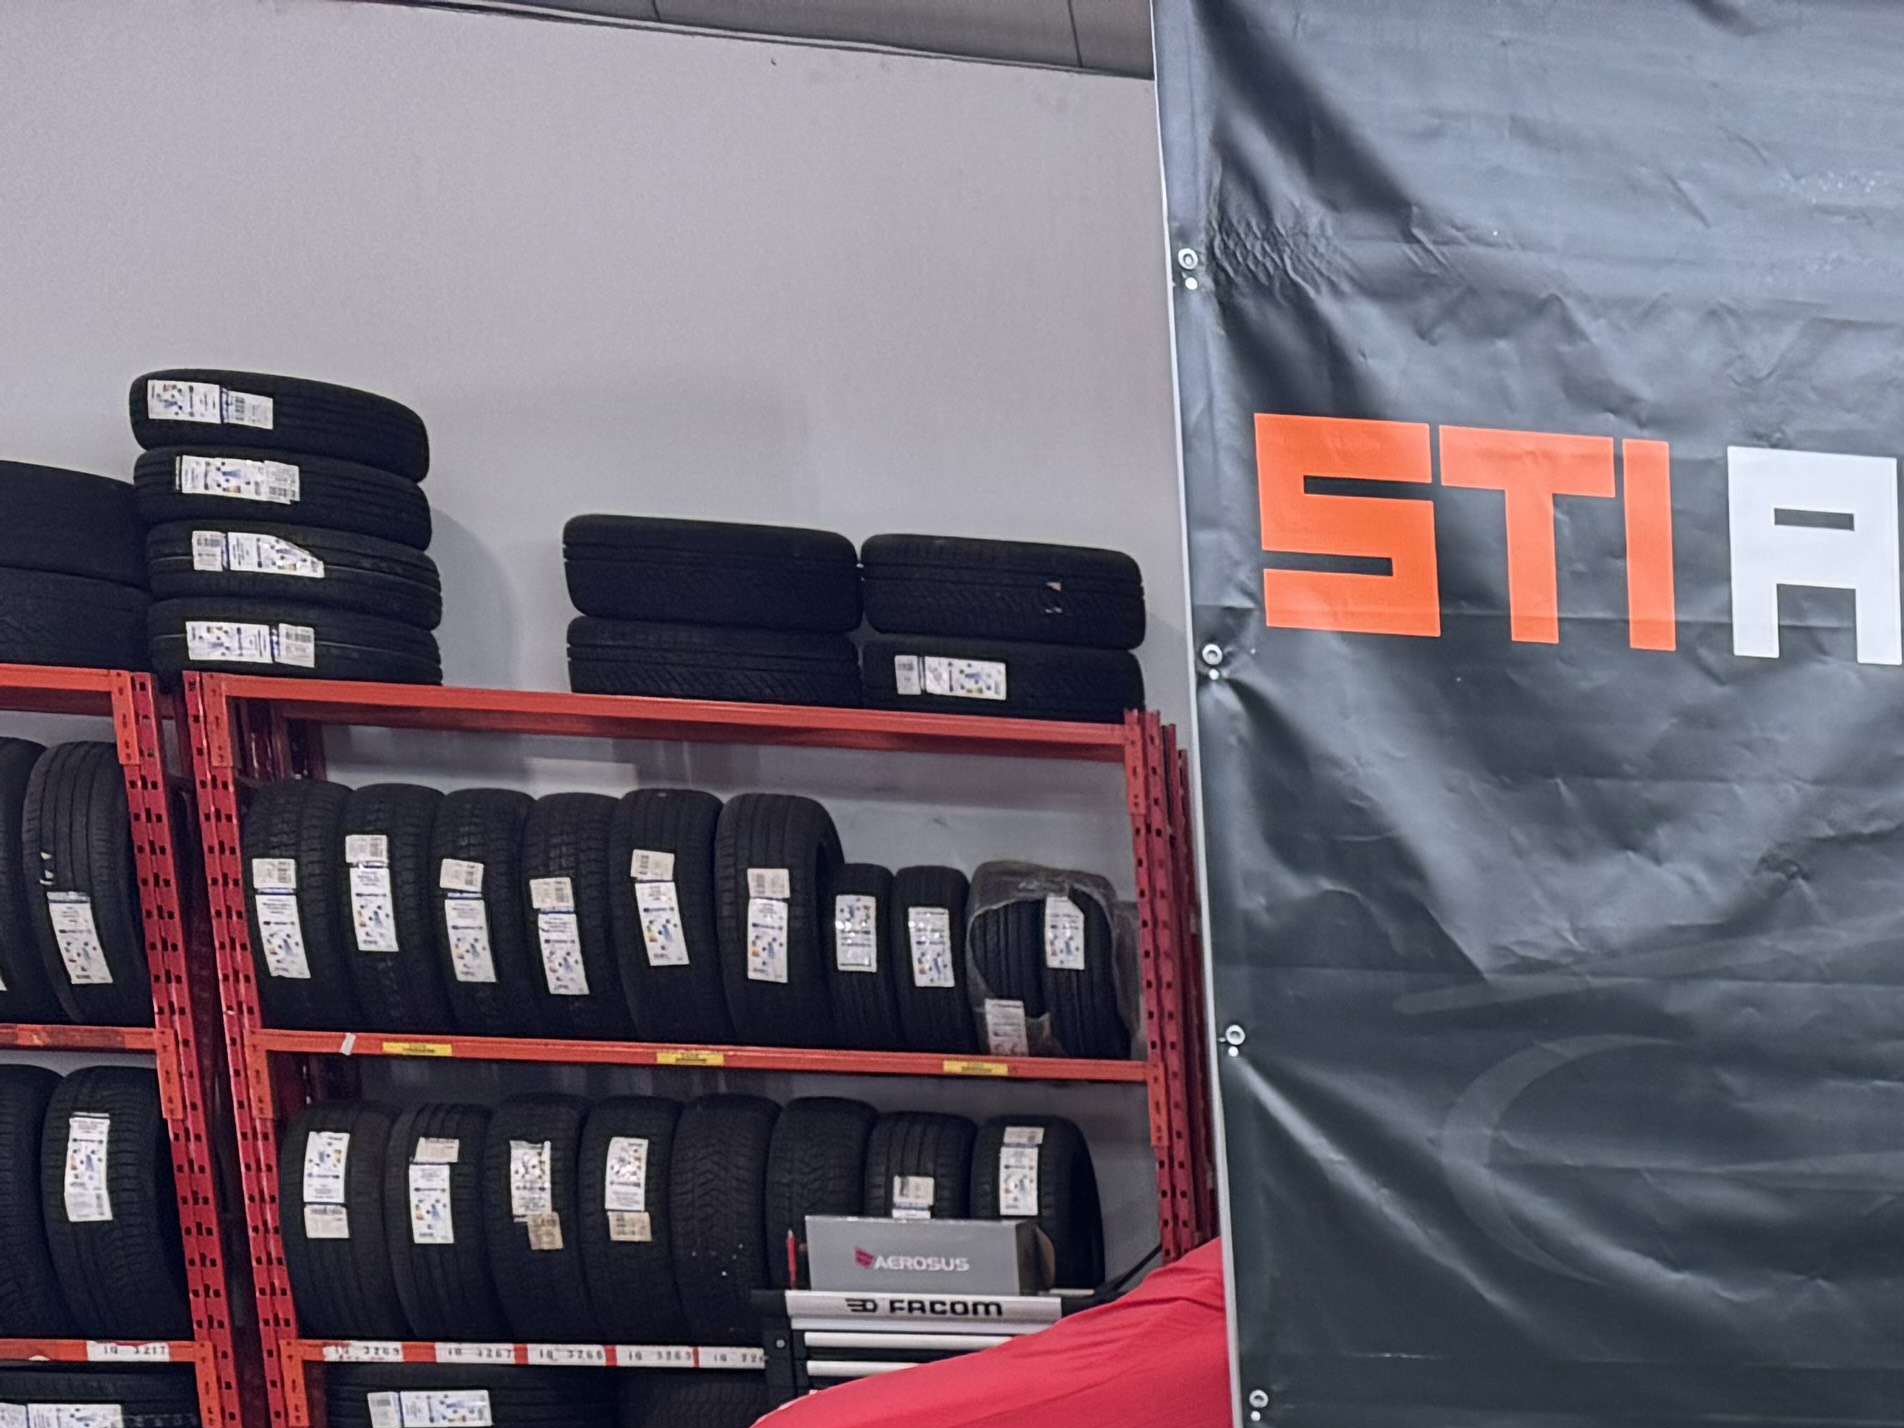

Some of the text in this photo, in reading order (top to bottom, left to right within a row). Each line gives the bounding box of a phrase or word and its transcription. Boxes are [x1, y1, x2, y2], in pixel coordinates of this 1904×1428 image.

[1253, 412, 1676, 652] STI
[873, 1251, 971, 1272] AEROSUS
[889, 1298, 1003, 1317] FACOM
